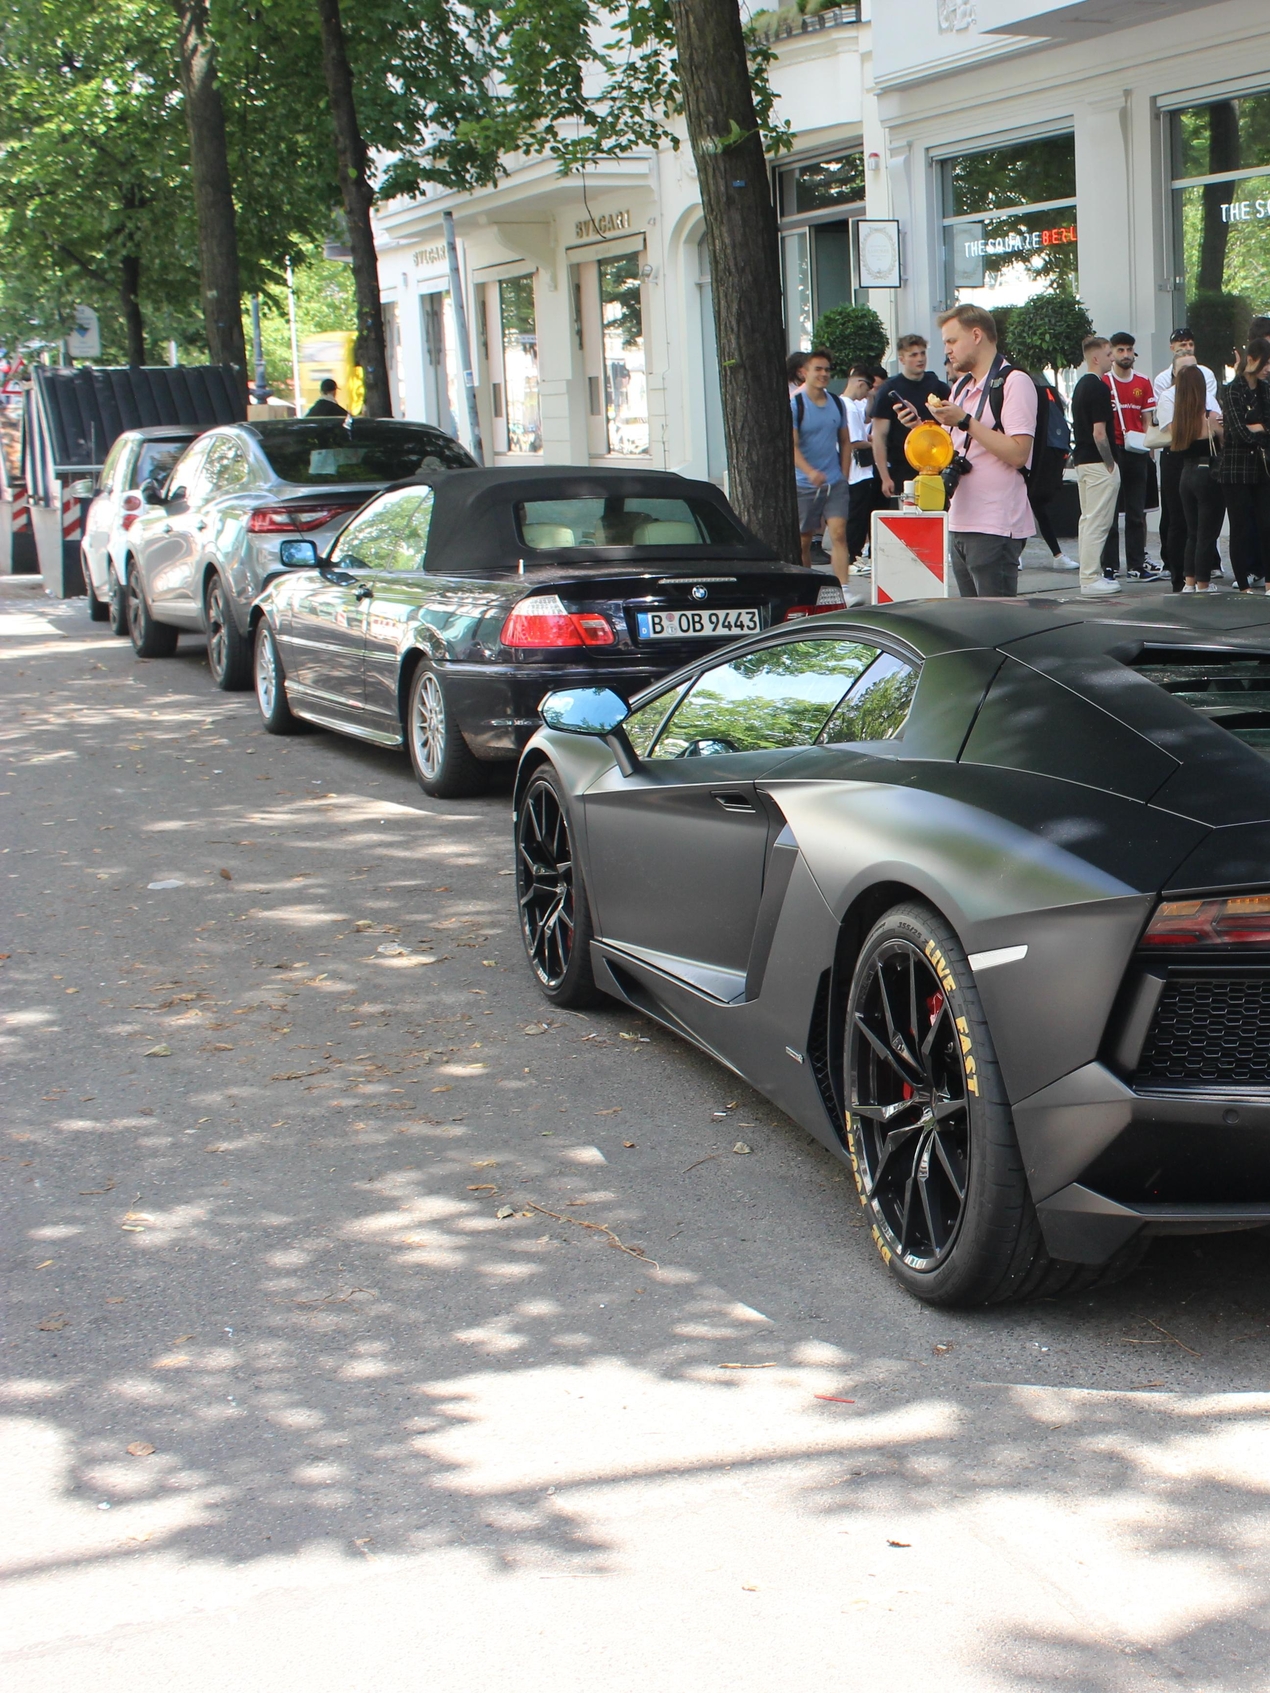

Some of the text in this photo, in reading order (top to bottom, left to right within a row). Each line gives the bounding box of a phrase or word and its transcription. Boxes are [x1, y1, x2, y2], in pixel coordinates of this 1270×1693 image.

[574, 209, 632, 239] BVLGARI
[1220, 202, 1250, 223] THE
[412, 244, 447, 266] BVLGAR
[964, 226, 1078, 258] THE SQUARE BERL
[651, 611, 758, 635] B OB 9443
[925, 939, 956, 996] LIVE
[955, 1016, 979, 1097] FAST
